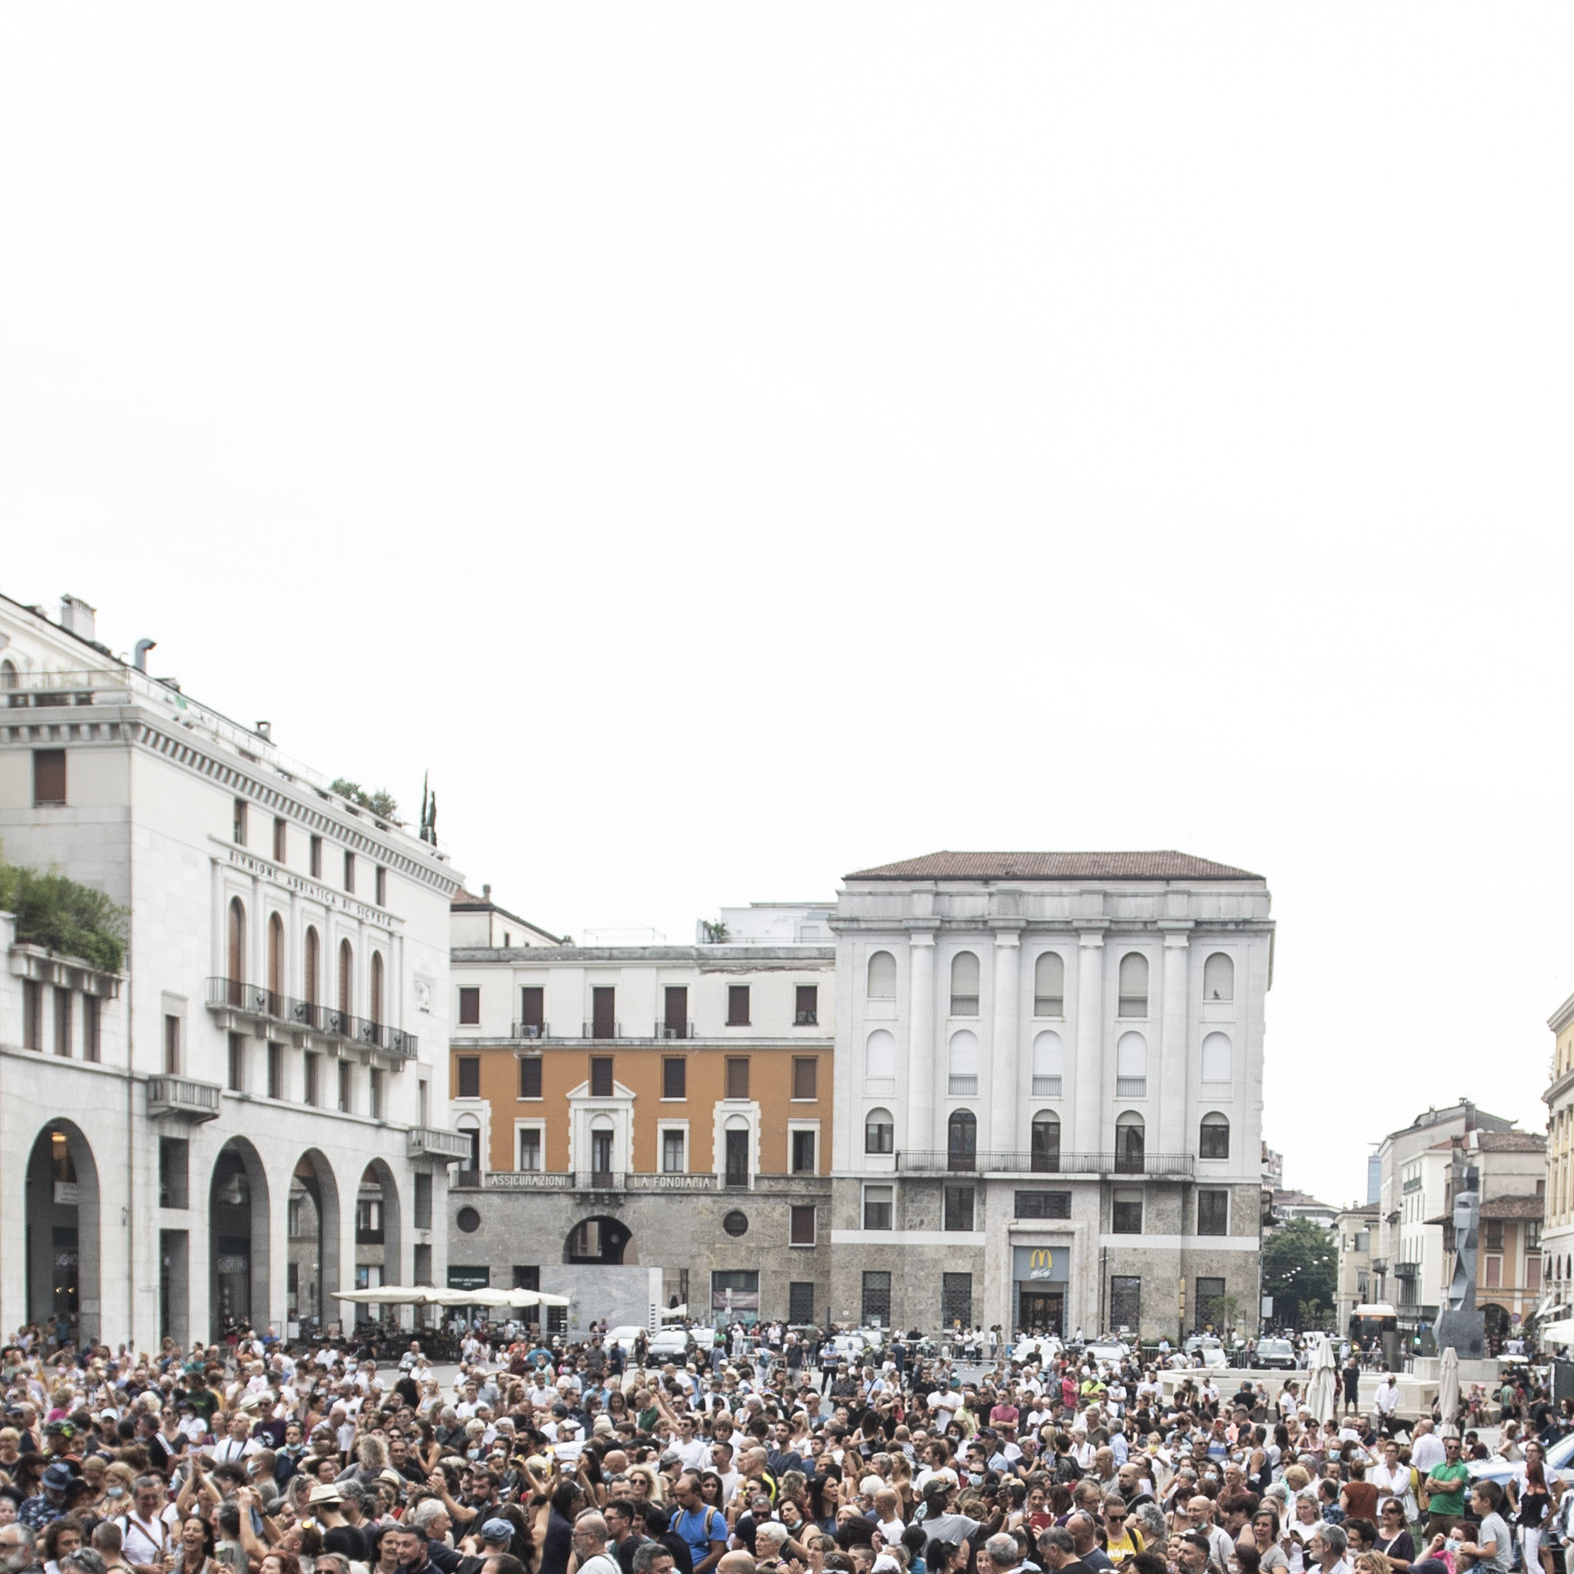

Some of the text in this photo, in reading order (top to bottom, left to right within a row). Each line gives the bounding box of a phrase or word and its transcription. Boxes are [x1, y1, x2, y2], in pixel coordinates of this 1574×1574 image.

[491, 1174, 566, 1187] ASSICURAZIONI
[634, 1175, 710, 1188] LA FONDIARIA
